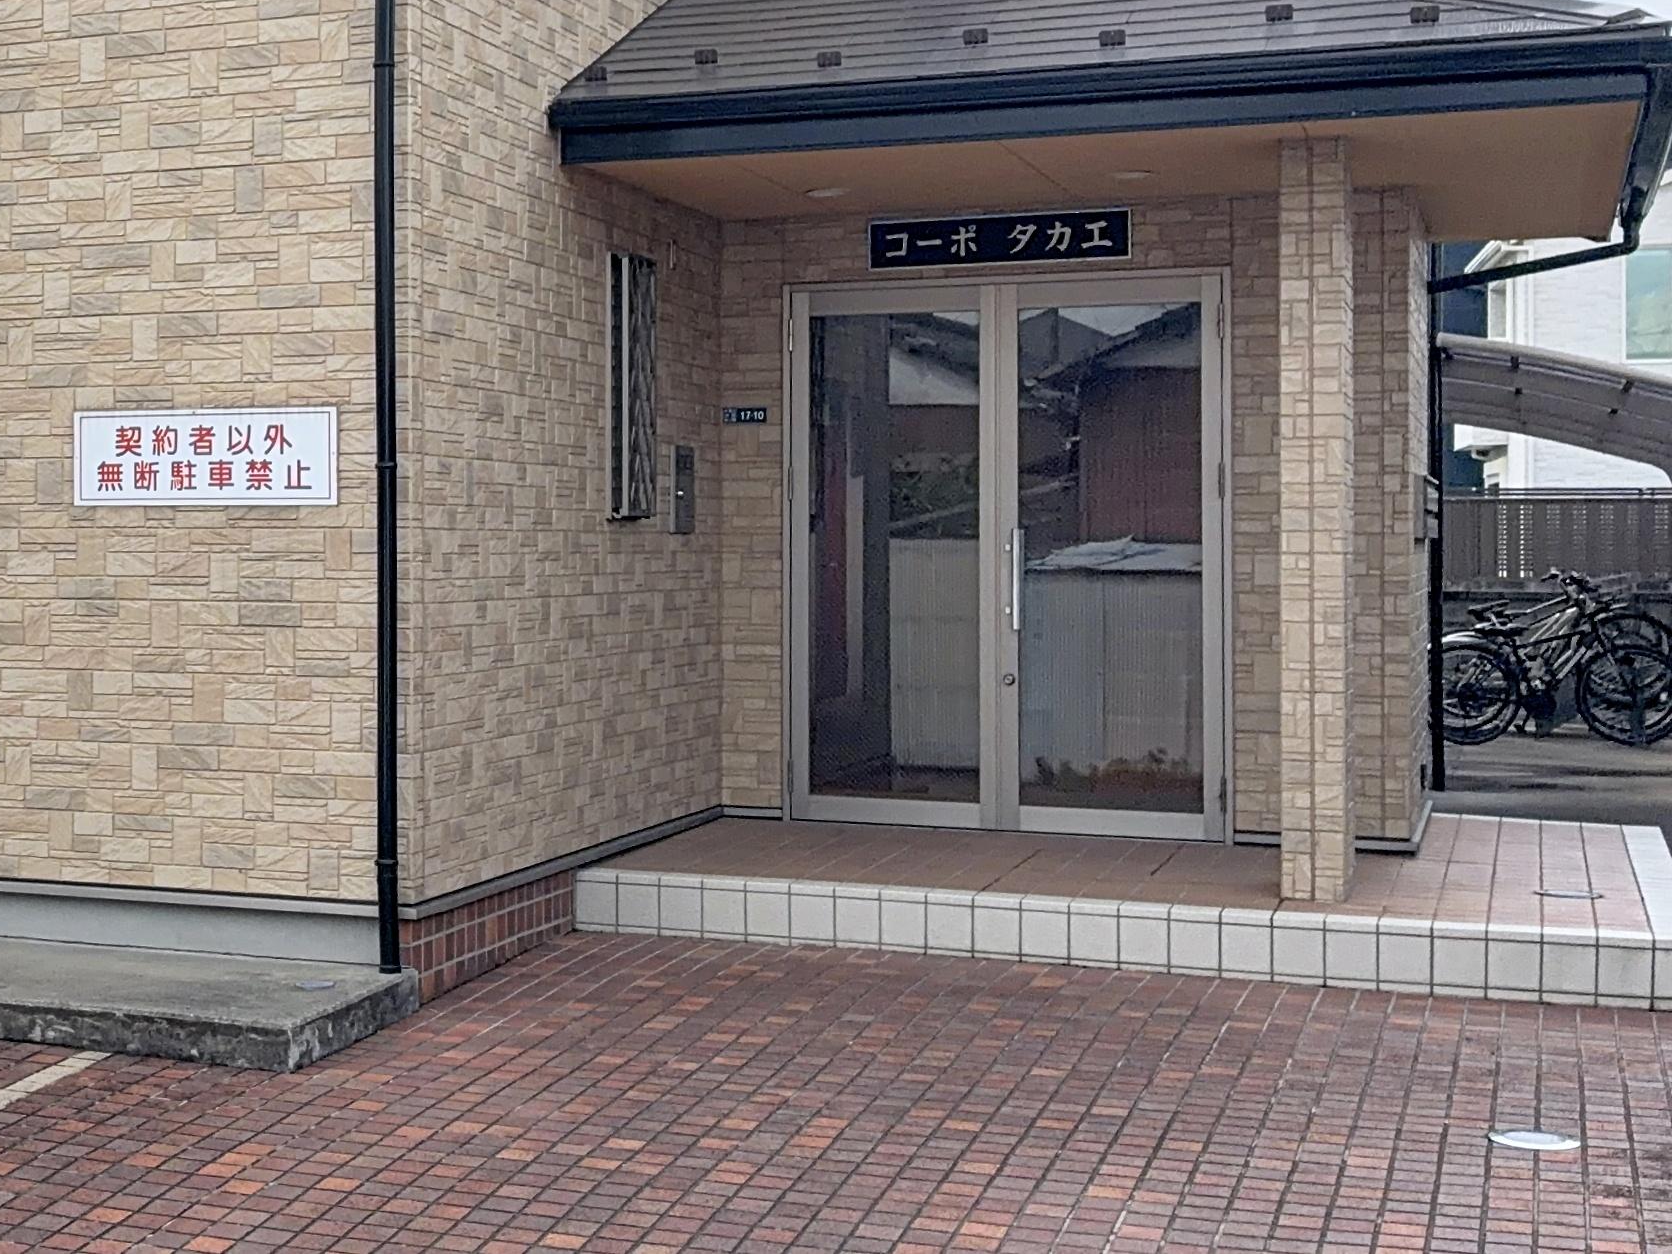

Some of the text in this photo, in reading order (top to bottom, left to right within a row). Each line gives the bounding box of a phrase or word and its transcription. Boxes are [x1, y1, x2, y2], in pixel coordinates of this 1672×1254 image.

[885, 224, 977, 257] コーポ
[115, 424, 292, 457] 契約者以外
[97, 459, 312, 491] 無断駐車禁止
